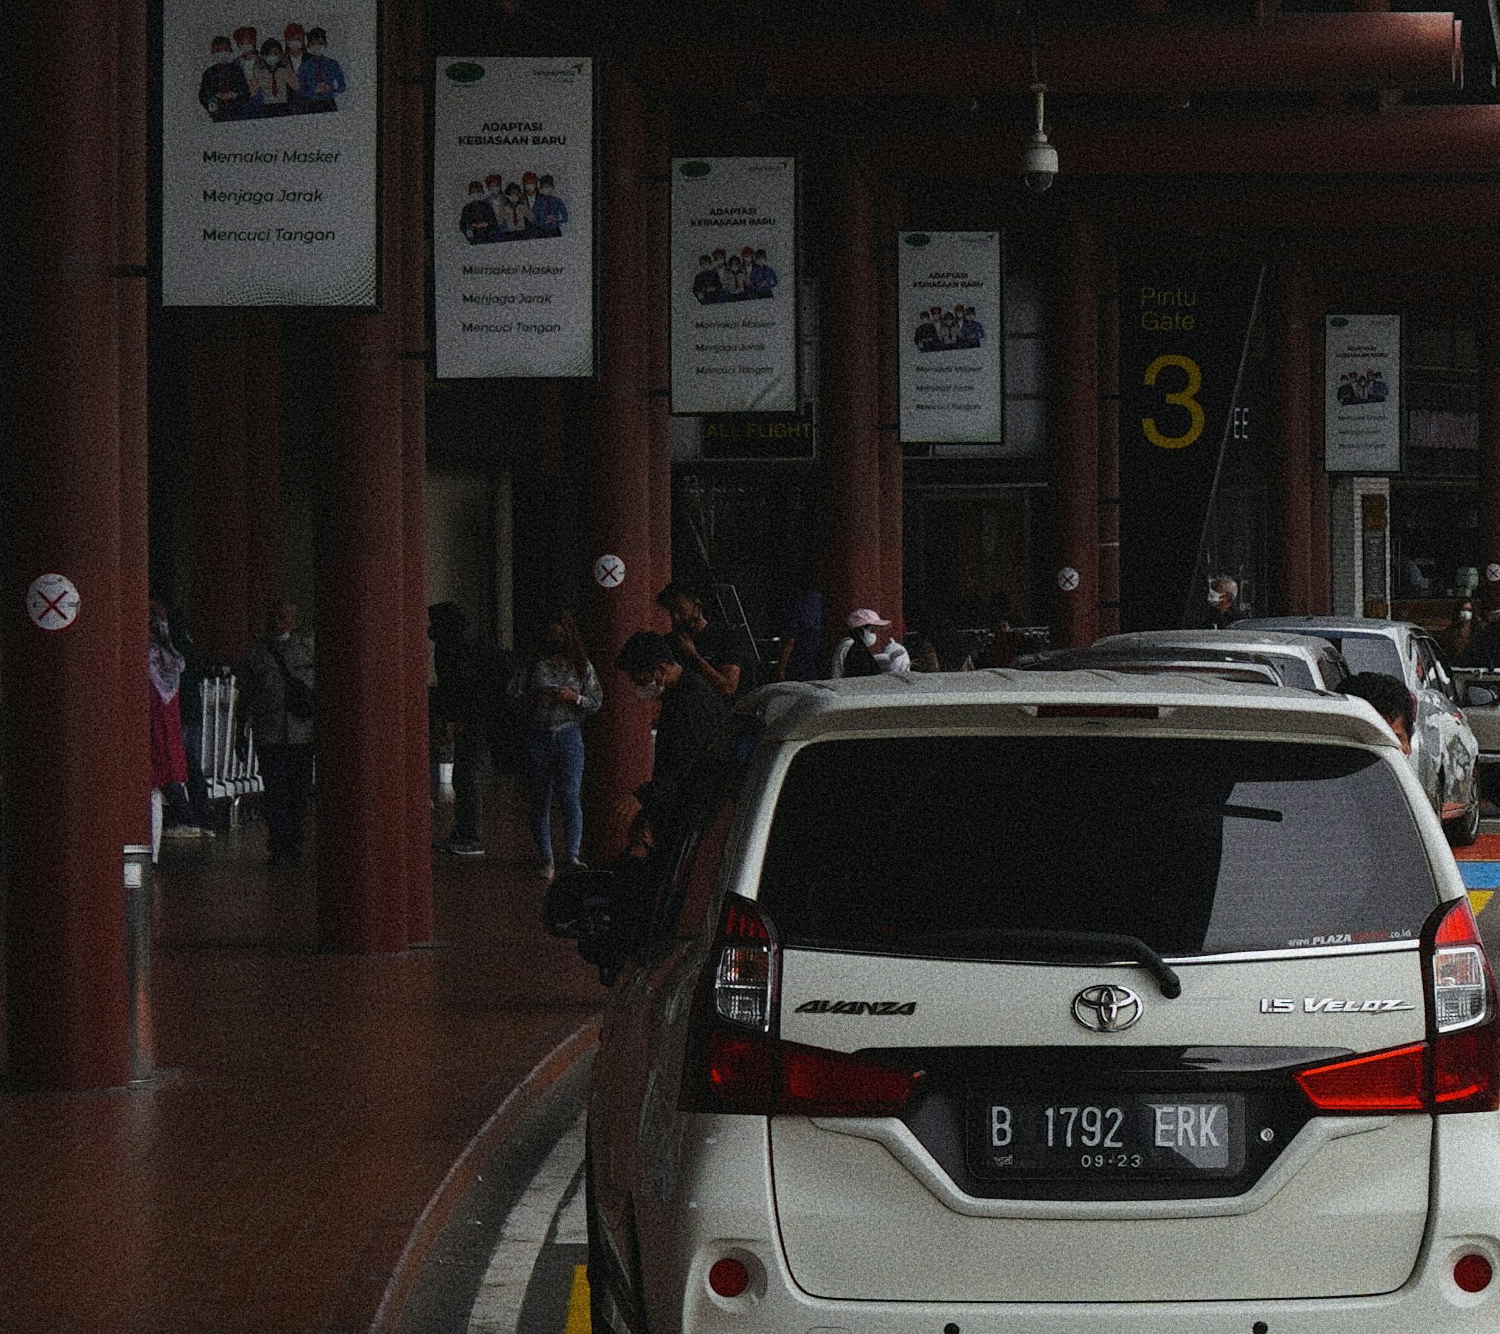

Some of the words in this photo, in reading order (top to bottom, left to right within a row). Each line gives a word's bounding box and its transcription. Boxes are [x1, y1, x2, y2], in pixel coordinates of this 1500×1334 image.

[481, 122, 543, 132] ADAPTASI
[458, 136, 528, 145] KEBIASAAN
[532, 136, 567, 145] BARU
[202, 150, 278, 164] Memakai
[282, 150, 341, 164] Masker
[202, 189, 274, 206] Menjaga
[279, 189, 323, 203] Jarak
[202, 228, 271, 242] Mencuci
[275, 228, 337, 245] Tangan
[1140, 286, 1197, 307] Pintu
[1141, 310, 1196, 332] Gate
[1141, 353, 1206, 450] 3
[706, 422, 740, 439] ALL
[746, 421, 812, 439] FLIGHT
[794, 999, 918, 1016] AVANZA
[991, 1106, 1012, 1147] B
[1044, 1106, 1124, 1148] 1792
[1153, 1106, 1220, 1147] ERK
